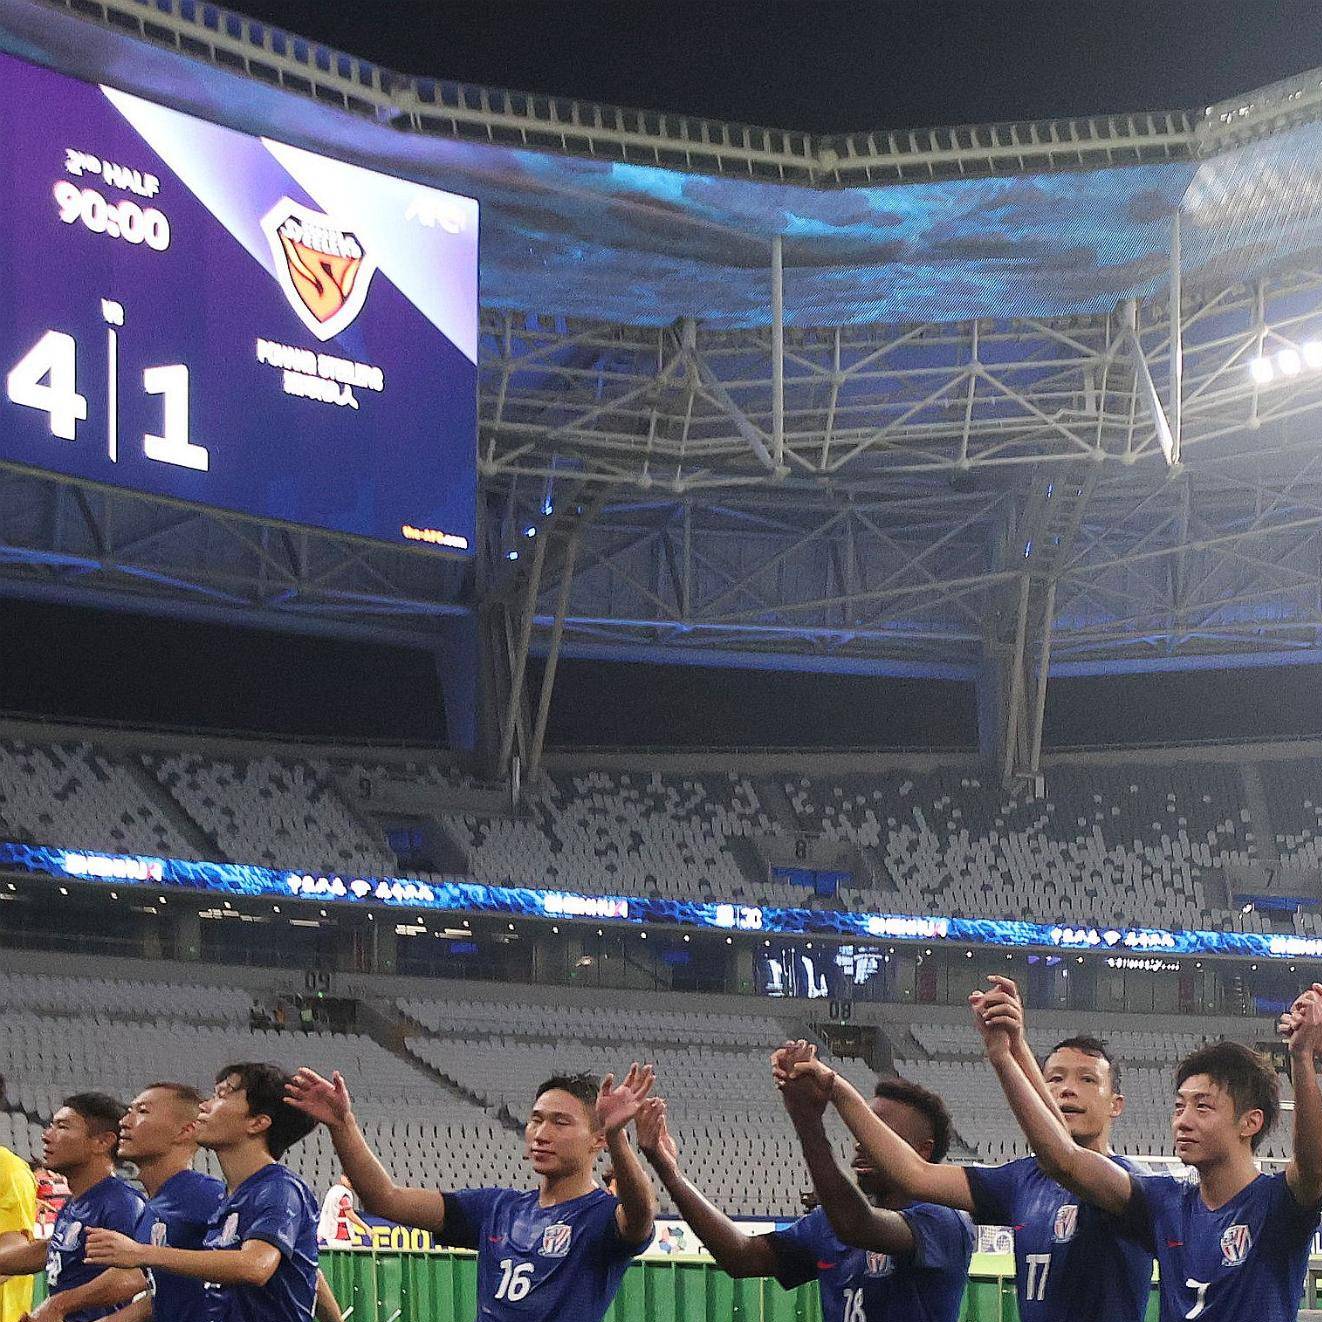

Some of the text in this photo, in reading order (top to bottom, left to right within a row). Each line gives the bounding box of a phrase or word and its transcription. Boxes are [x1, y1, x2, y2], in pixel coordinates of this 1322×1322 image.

[102, 160, 160, 198] HALF
[53, 180, 170, 251] 90:00
[7, 330, 87, 440] 4
[143, 363, 209, 471] 1
[494, 1259, 534, 1302] 16
[1025, 1253, 1051, 1302] 17
[1184, 1278, 1209, 1319] 7
